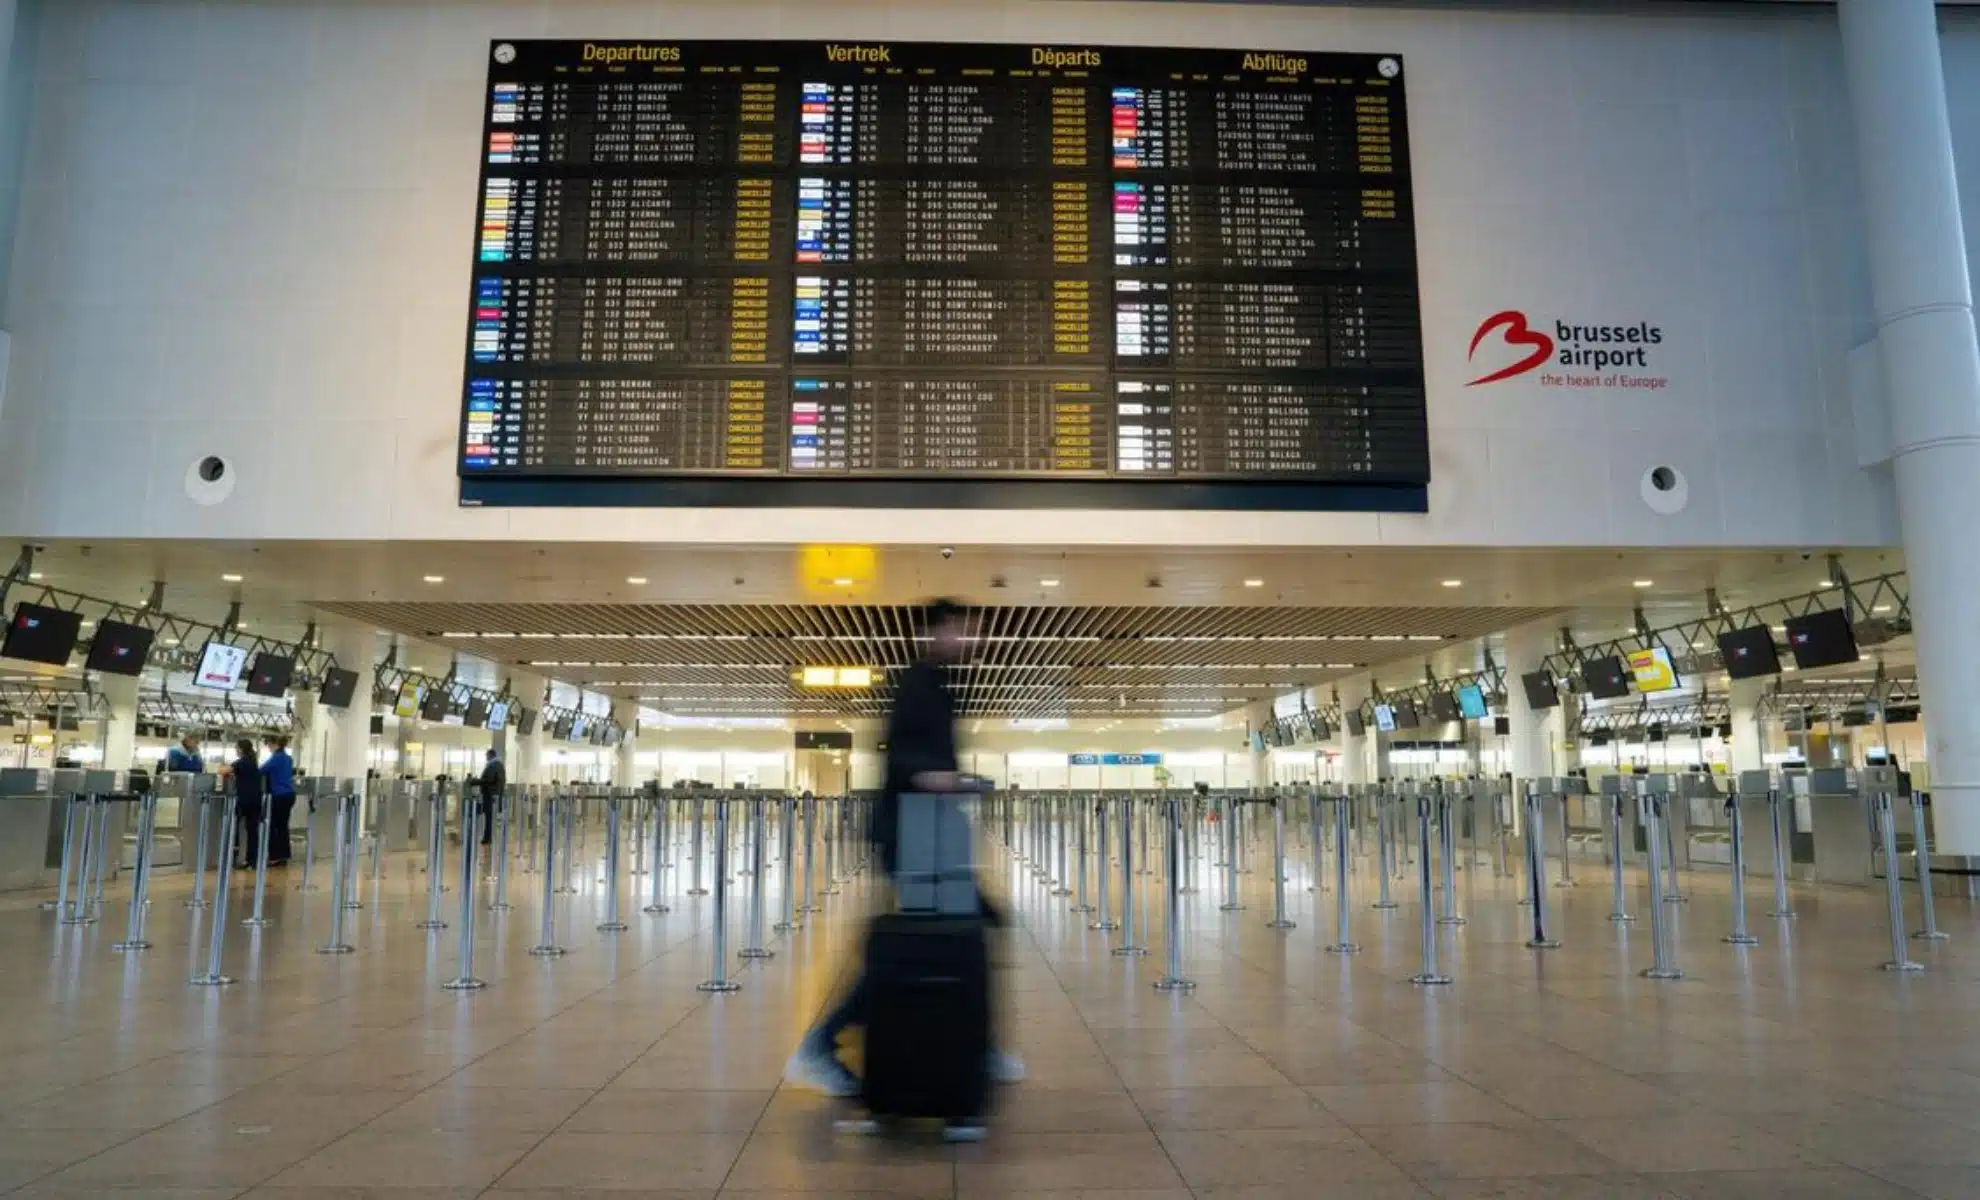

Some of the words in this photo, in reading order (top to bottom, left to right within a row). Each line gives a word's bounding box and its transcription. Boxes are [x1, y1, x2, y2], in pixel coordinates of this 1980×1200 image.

[583, 43, 681, 63] Departures
[826, 44, 891, 62] Vertrek
[1032, 48, 1101, 69] Départs
[1243, 53, 1308, 73] Abflüge
[1556, 319, 1662, 344] brussels
[1559, 344, 1647, 370] airport
[1541, 373, 1564, 386] the
[1567, 374, 1601, 387] heart
[1604, 374, 1617, 387] of
[1620, 375, 1668, 390] Europe
